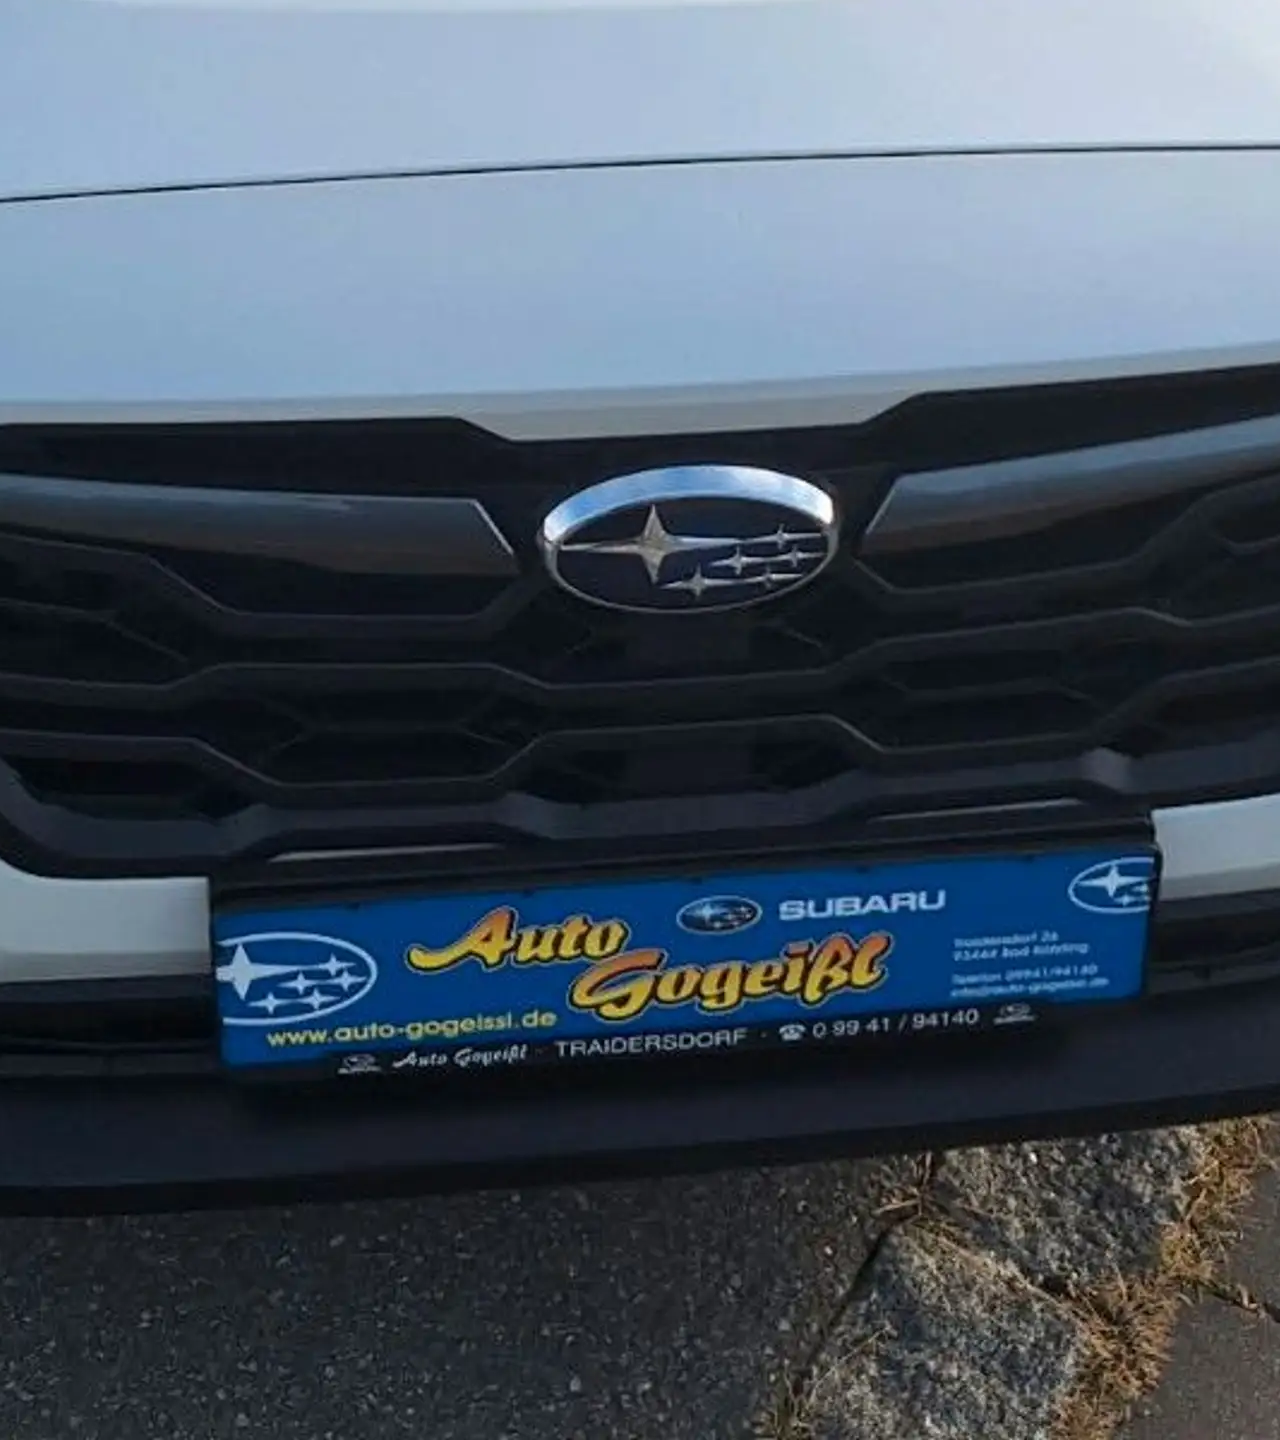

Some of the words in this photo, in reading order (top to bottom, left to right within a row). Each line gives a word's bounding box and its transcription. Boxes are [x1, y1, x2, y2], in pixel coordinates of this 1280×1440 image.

[779, 890, 947, 922] SUBARU
[406, 906, 630, 972] Auto
[568, 931, 894, 1023] Gogeißl
[266, 1009, 559, 1047] www.auto-gogeissl.de
[392, 1050, 448, 1068] Auto
[555, 1028, 748, 1058] TRAIDERSDORF
[912, 1008, 980, 1030] 94140
